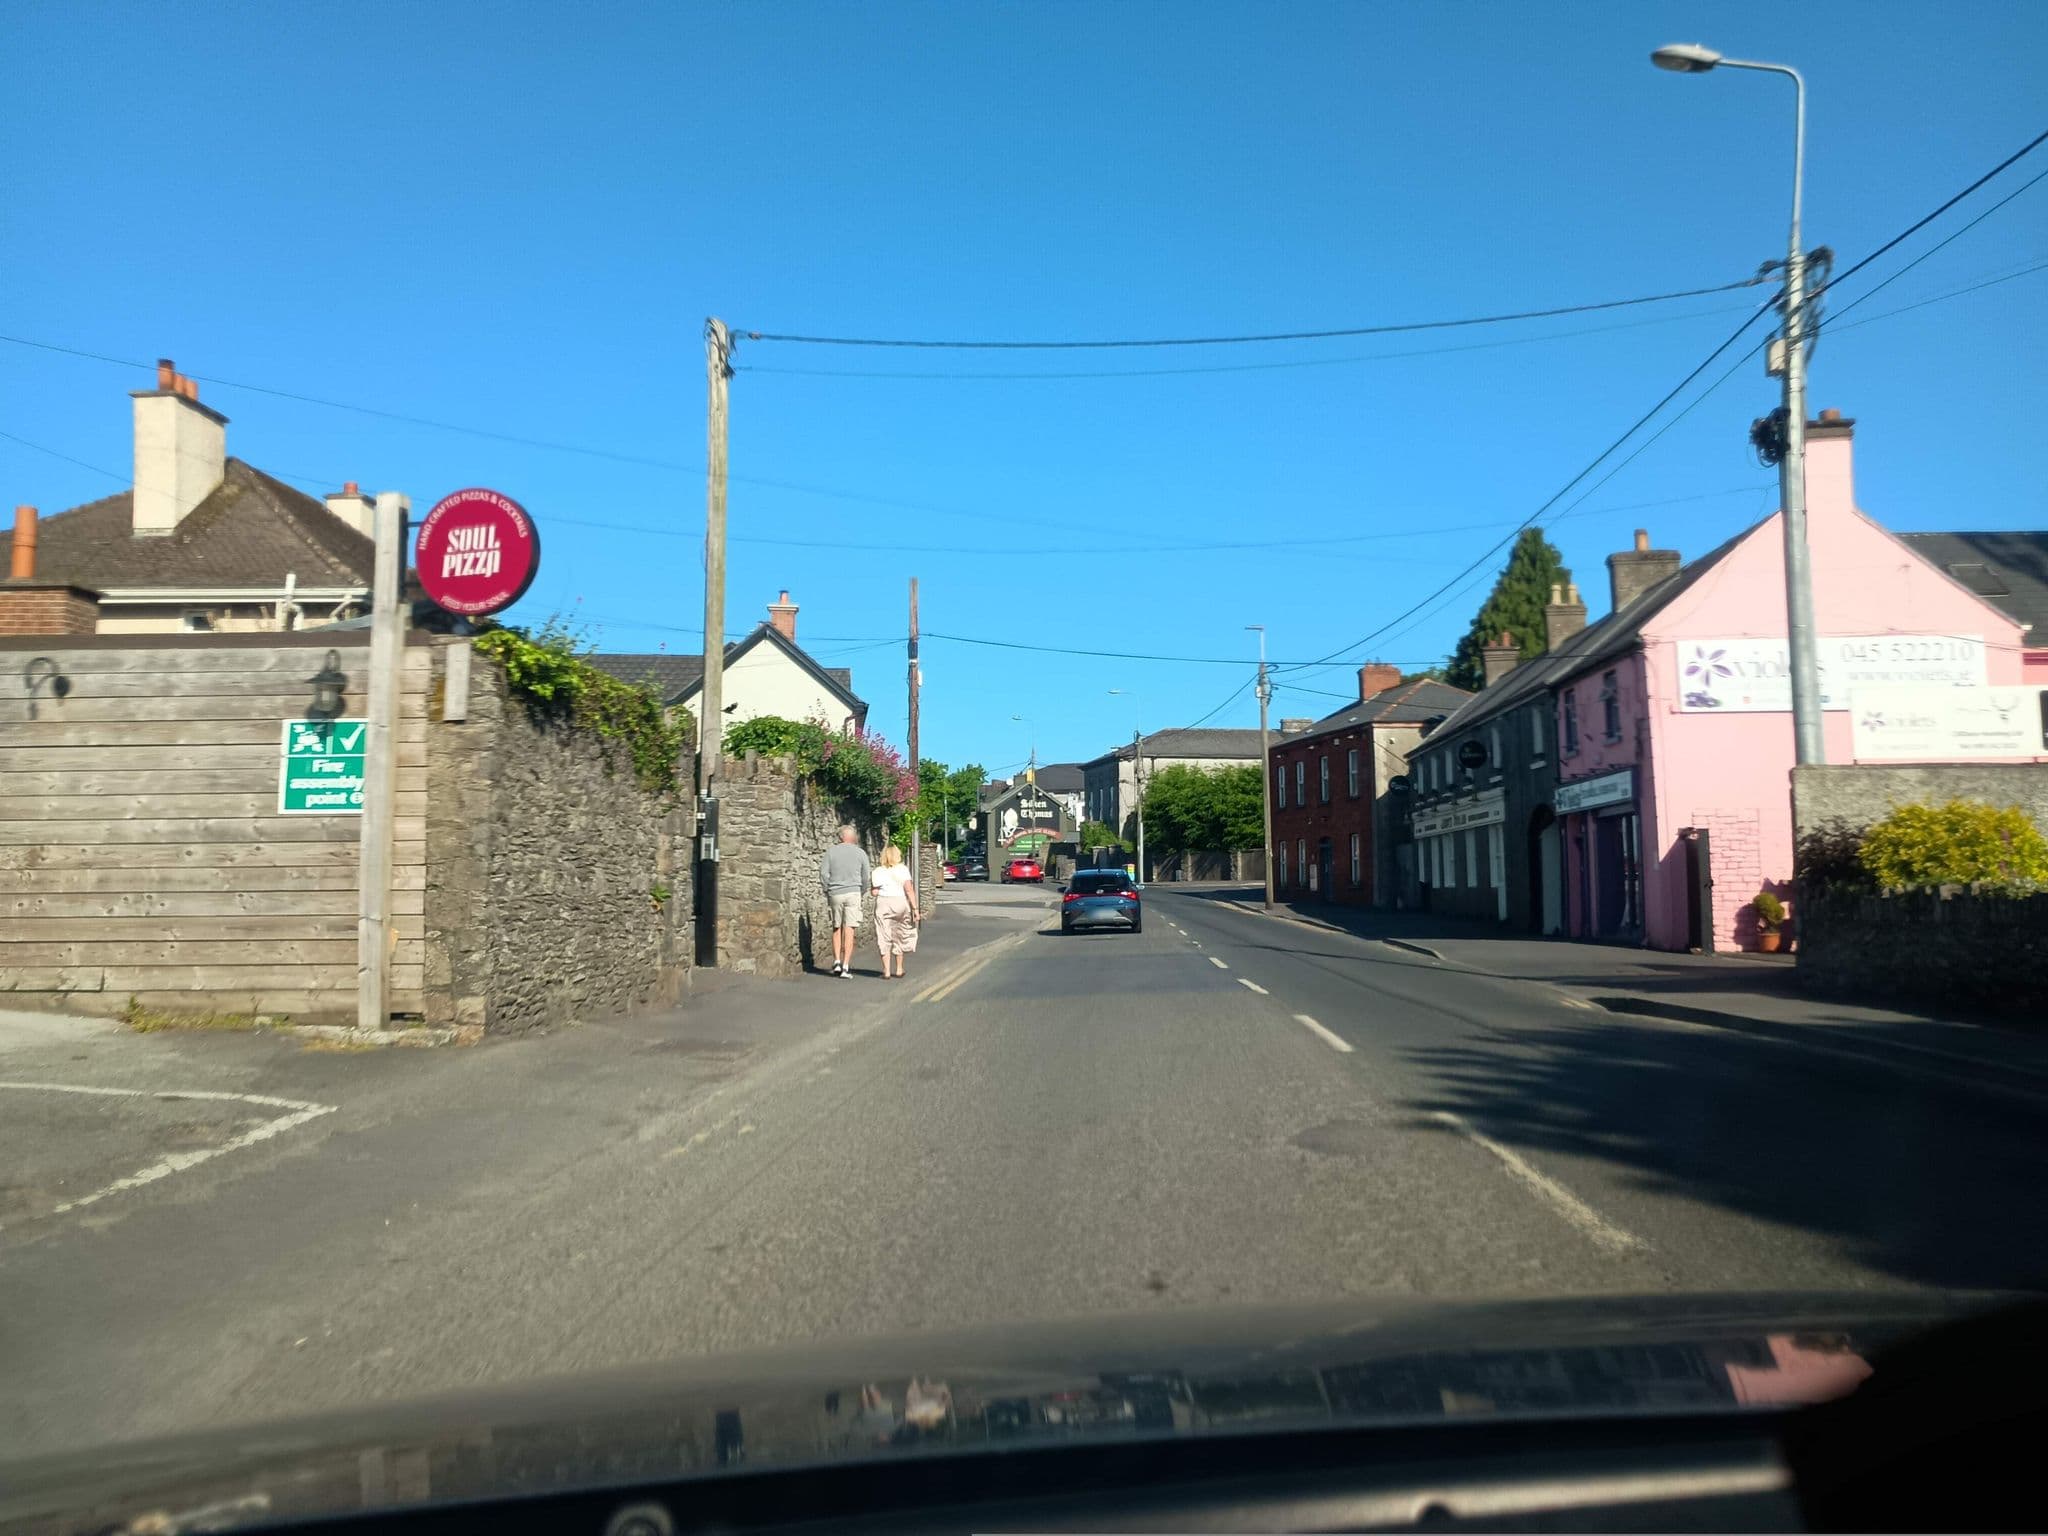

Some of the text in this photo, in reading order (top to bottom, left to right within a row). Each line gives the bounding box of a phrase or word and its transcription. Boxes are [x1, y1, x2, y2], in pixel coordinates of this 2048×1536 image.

[418, 491, 528, 551] HAND CRAFTED PIZZAS & COCKTAILS
[447, 524, 501, 553] SOUL
[441, 550, 501, 578] PIZZA
[1840, 641, 1975, 662] 045 522210
[311, 759, 345, 773] Fire
[305, 792, 347, 808] point
